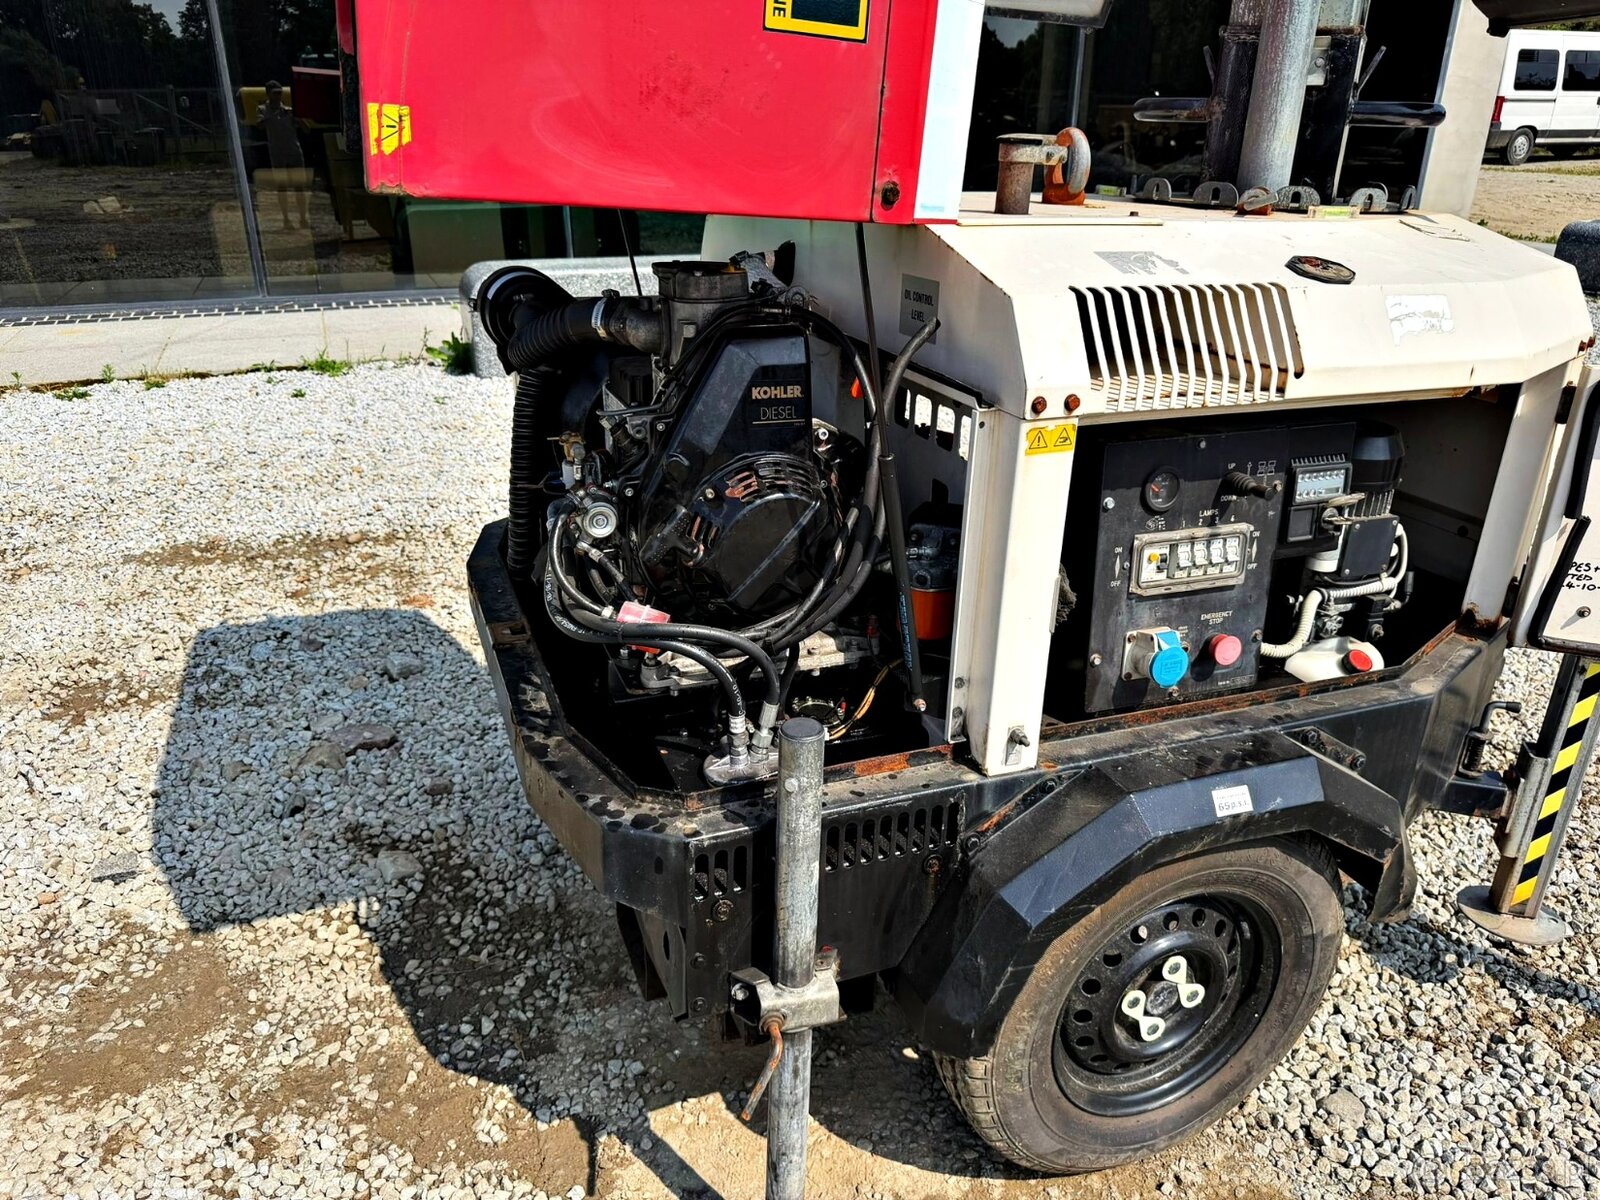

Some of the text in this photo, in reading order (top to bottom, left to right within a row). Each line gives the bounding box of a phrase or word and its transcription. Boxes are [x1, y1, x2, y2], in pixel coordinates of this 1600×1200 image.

[913, 290, 934, 307] CONTROL
[911, 308, 925, 322] LEVEL
[752, 385, 802, 399] KOHLER
[760, 406, 797, 420] DIESEL
[1199, 508, 1219, 517] LAMPS
[1201, 610, 1233, 621] EMERGENCY
[1208, 617, 1223, 625] STOP
